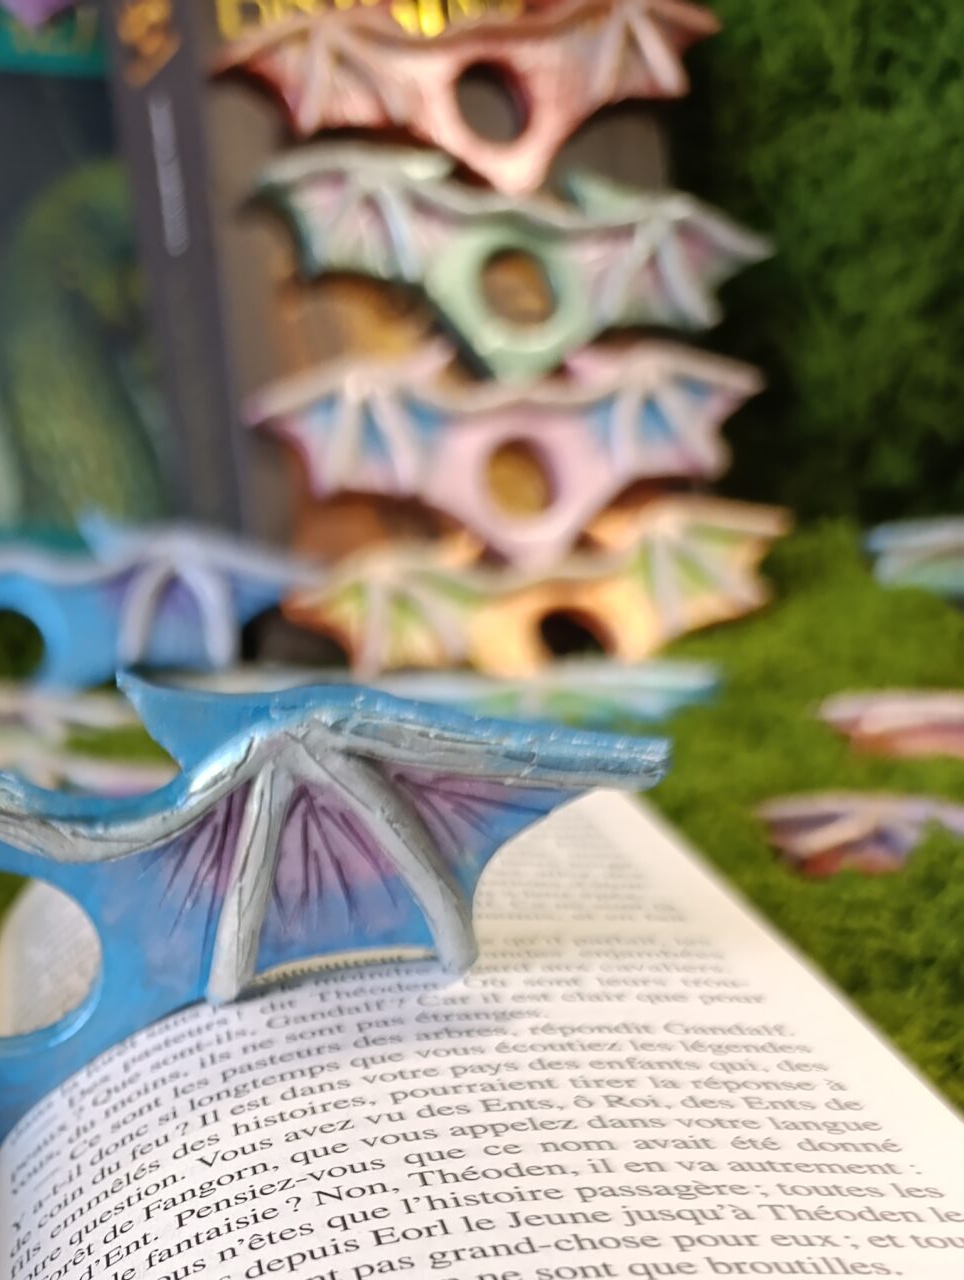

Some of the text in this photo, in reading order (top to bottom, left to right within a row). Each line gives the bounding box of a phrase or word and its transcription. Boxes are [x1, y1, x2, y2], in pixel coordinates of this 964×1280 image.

[102, 1219, 135, 1244] de
[142, 1161, 279, 1221] Fangorn,
[290, 1140, 349, 1166] que
[357, 1126, 438, 1148] vous
[449, 1116, 578, 1139] appelez
[587, 1114, 666, 1131] dans
[675, 1116, 763, 1132] votre
[772, 1115, 883, 1135] langue
[175, 1158, 386, 1229] Pensiez-vous
[403, 1147, 466, 1167] que
[483, 1143, 523, 1156] ce
[540, 1139, 618, 1153] nom
[633, 1135, 716, 1151] avait
[730, 1136, 781, 1151] été
[796, 1138, 903, 1153] donné
[315, 1182, 399, 1206] Non,
[407, 1165, 579, 1188] Théoden,
[587, 1158, 615, 1174] il
[623, 1160, 668, 1174] en
[675, 1160, 719, 1173] va
[217, 1221, 315, 1263] n'êtes
[326, 1204, 391, 1231] que
[400, 1184, 565, 1214] l'histoire
[776, 1182, 885, 1198] toutes
[890, 1182, 946, 1199] les
[244, 1237, 360, 1280] depuis
[371, 1218, 453, 1248] Eorl
[461, 1215, 496, 1233] le
[507, 1209, 612, 1229] Jeune
[621, 1204, 756, 1227] jusqu'à
[756, 1204, 926, 1223] Théoden
[428, 1233, 662, 1270] grand-chose
[670, 1233, 761, 1252] pour
[867, 1234, 906, 1248] et
[535, 1261, 618, 1280] sont
[628, 1261, 699, 1280] que
[704, 1257, 904, 1276] broutilles.
